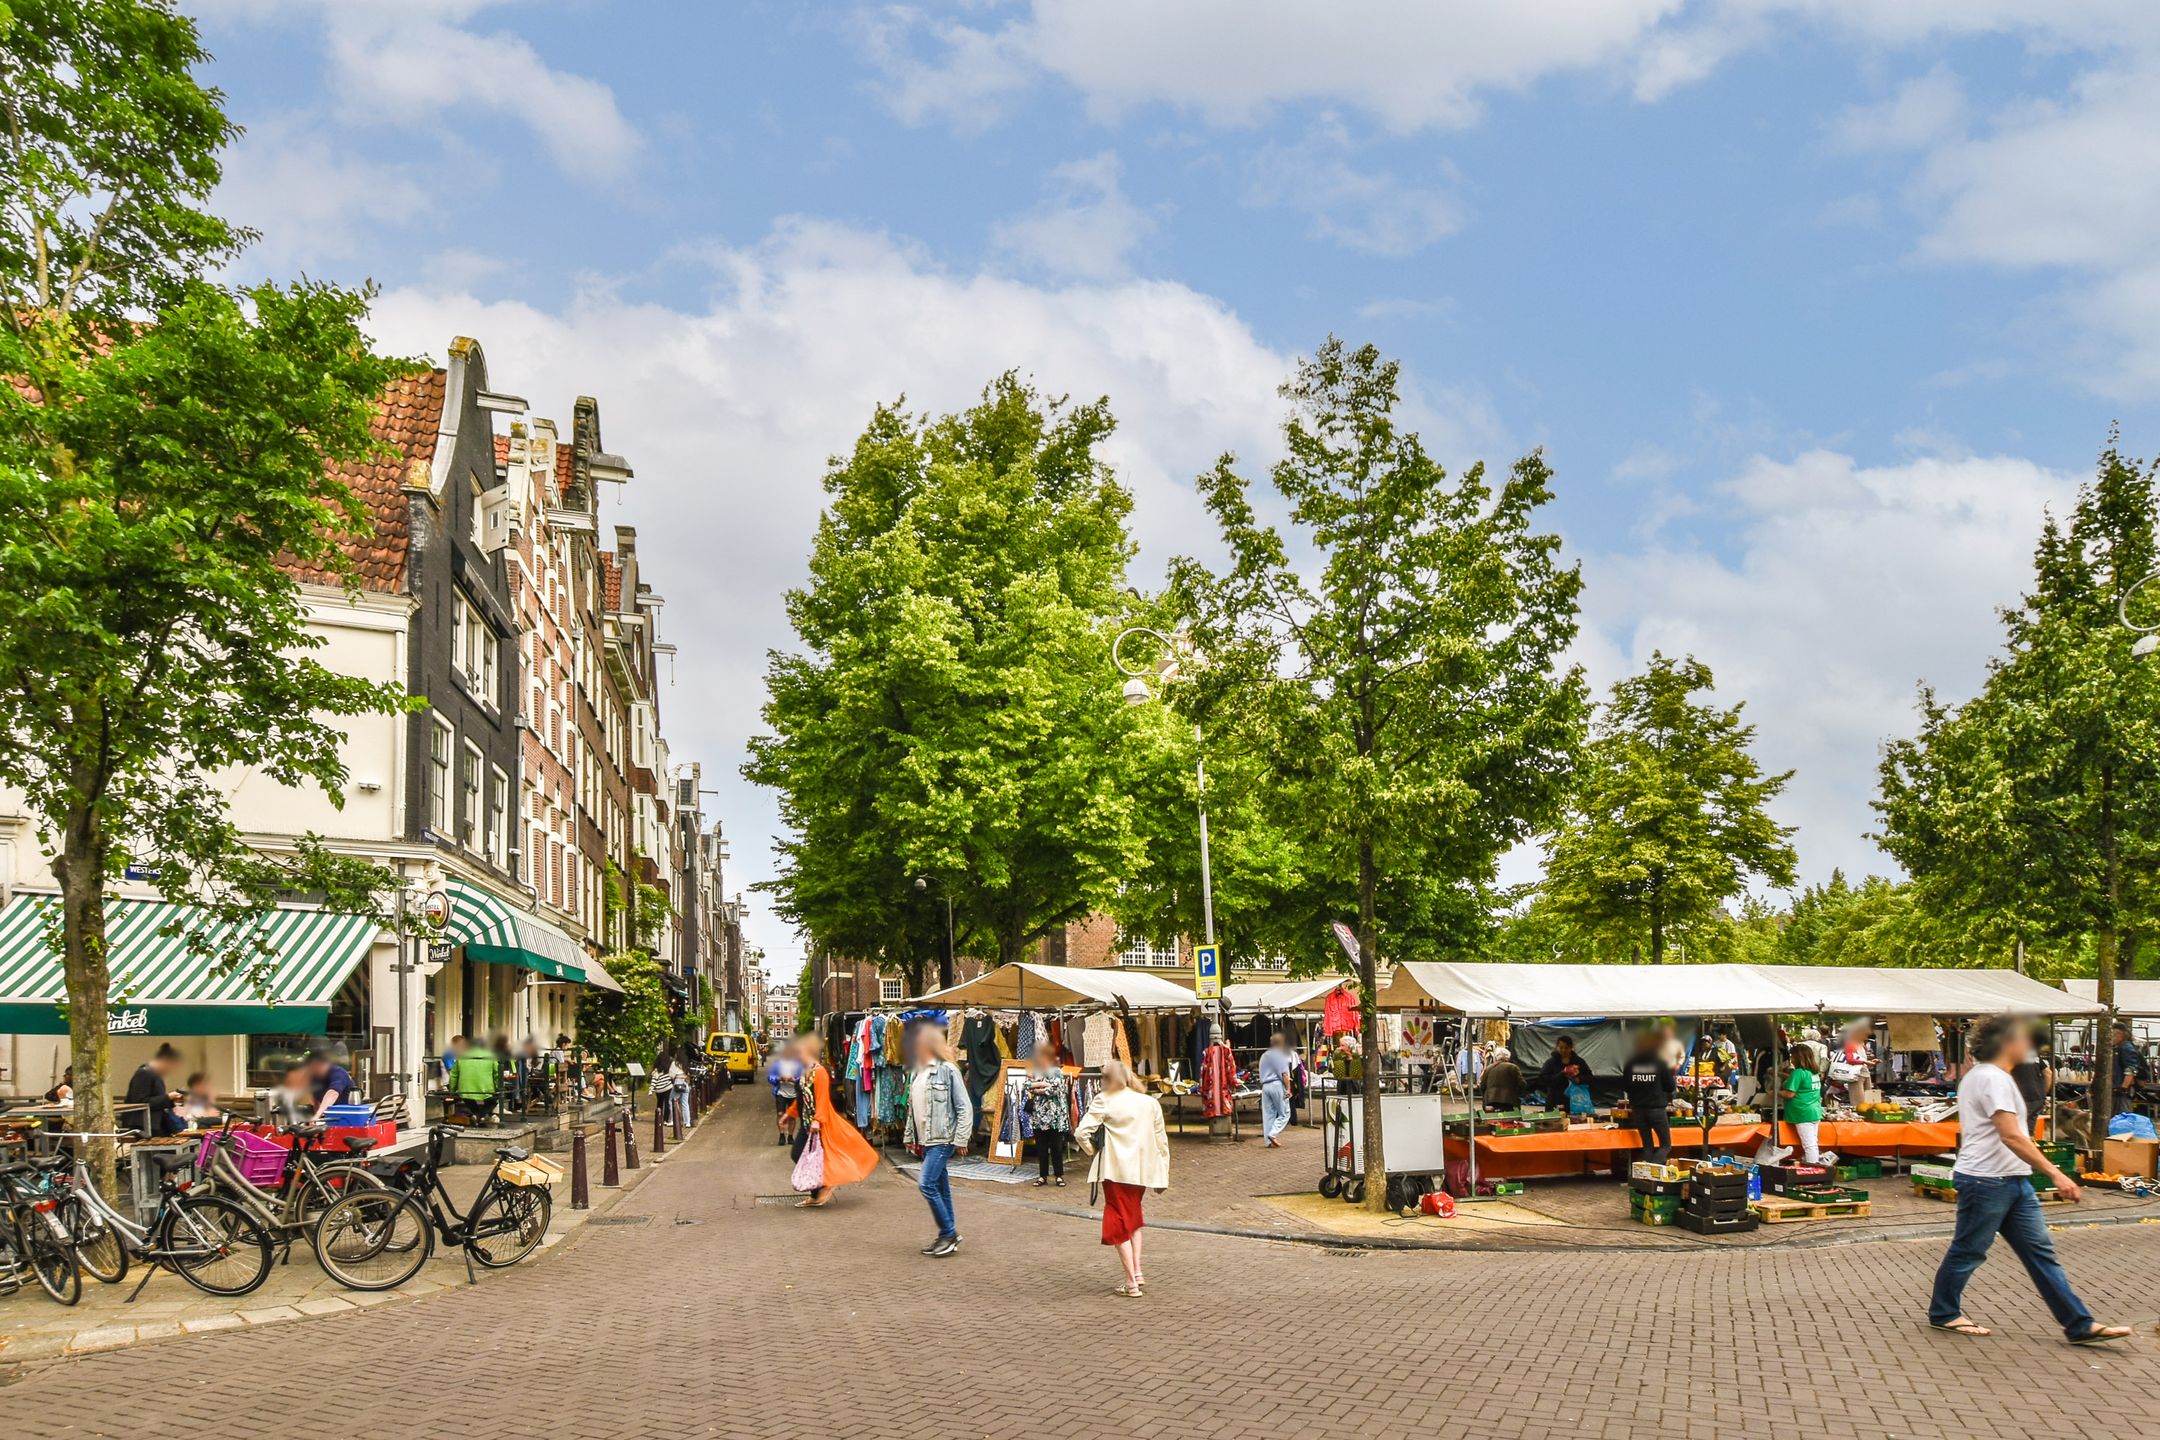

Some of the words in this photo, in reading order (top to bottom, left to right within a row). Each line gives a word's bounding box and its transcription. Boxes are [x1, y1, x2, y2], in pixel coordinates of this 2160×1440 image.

[129, 865, 163, 875] WESTERS
[1201, 952, 1212, 974] P
[107, 1008, 149, 1033] inkel
[1632, 1074, 1656, 1082] FRUIT
